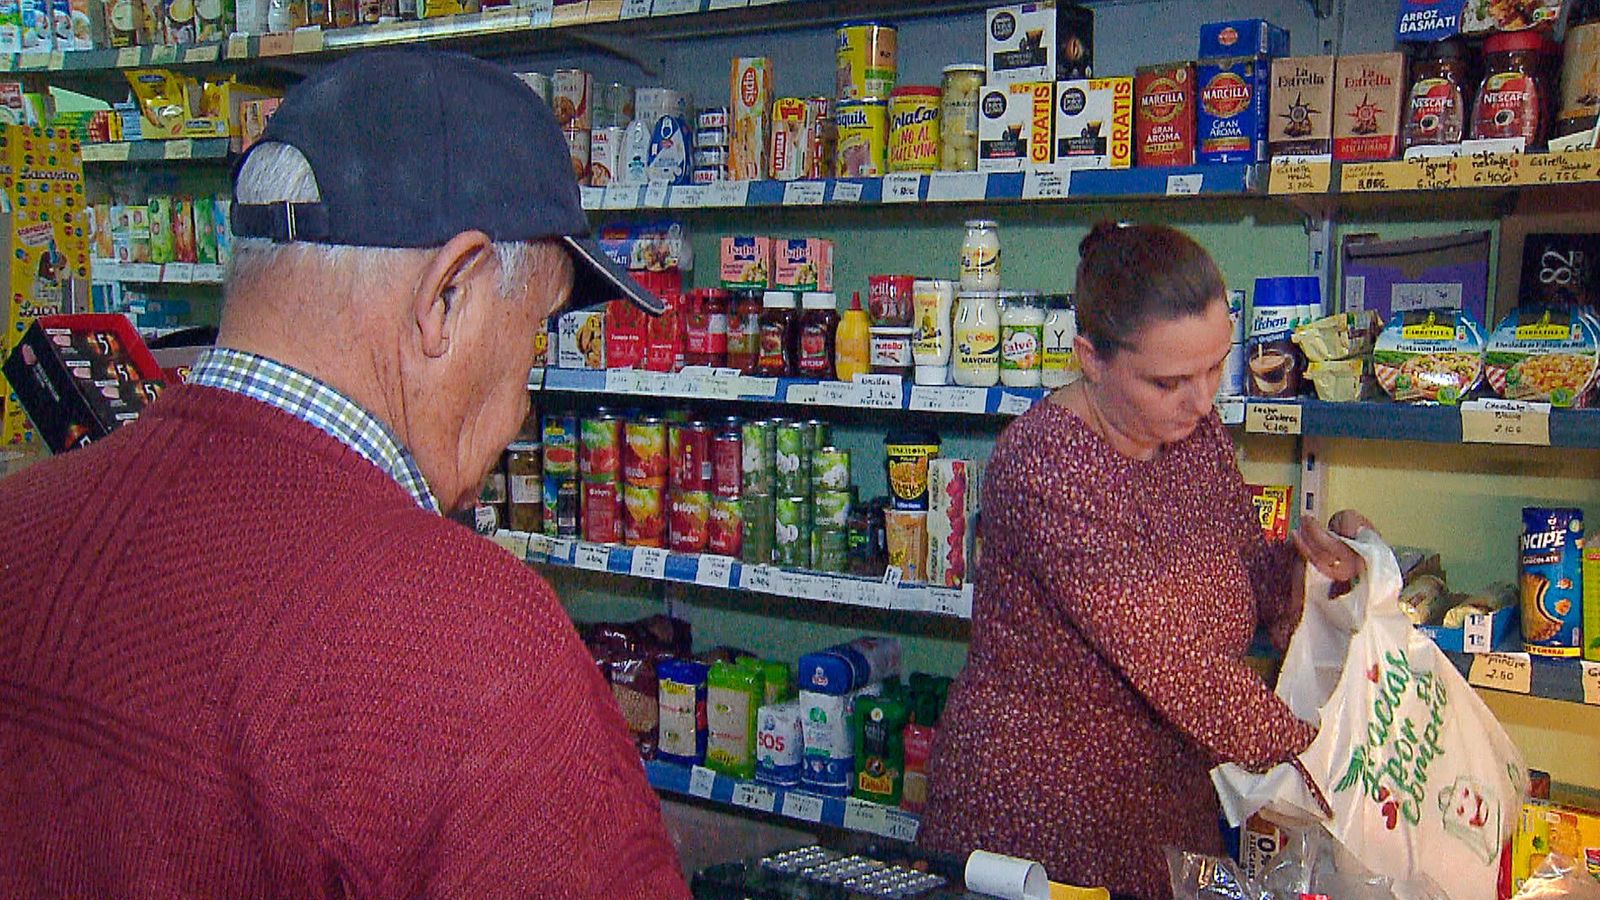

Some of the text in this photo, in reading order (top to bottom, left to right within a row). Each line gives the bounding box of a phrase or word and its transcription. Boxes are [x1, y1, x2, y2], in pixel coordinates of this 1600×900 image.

[1402, 10, 1438, 22] ARROZ
[1400, 15, 1456, 33] BASMATI
[1296, 67, 1308, 77] La
[1363, 68, 1375, 78] La
[1278, 73, 1325, 88] Estrella
[1345, 75, 1392, 88] Estrella
[1141, 92, 1183, 107] MARCILLA
[1202, 87, 1249, 101] MARCILLA
[1032, 85, 1050, 162] GRATIS
[1113, 80, 1131, 160] GRATIS
[1213, 119, 1239, 129] GRAN
[1152, 126, 1174, 135] GRAN
[1210, 126, 1242, 137] AROMA
[1146, 133, 1181, 143] AROMA
[728, 243, 761, 256] Isabel
[783, 246, 812, 258] Isabel
[758, 730, 785, 753] SOS
[1383, 717, 1419, 796] por
